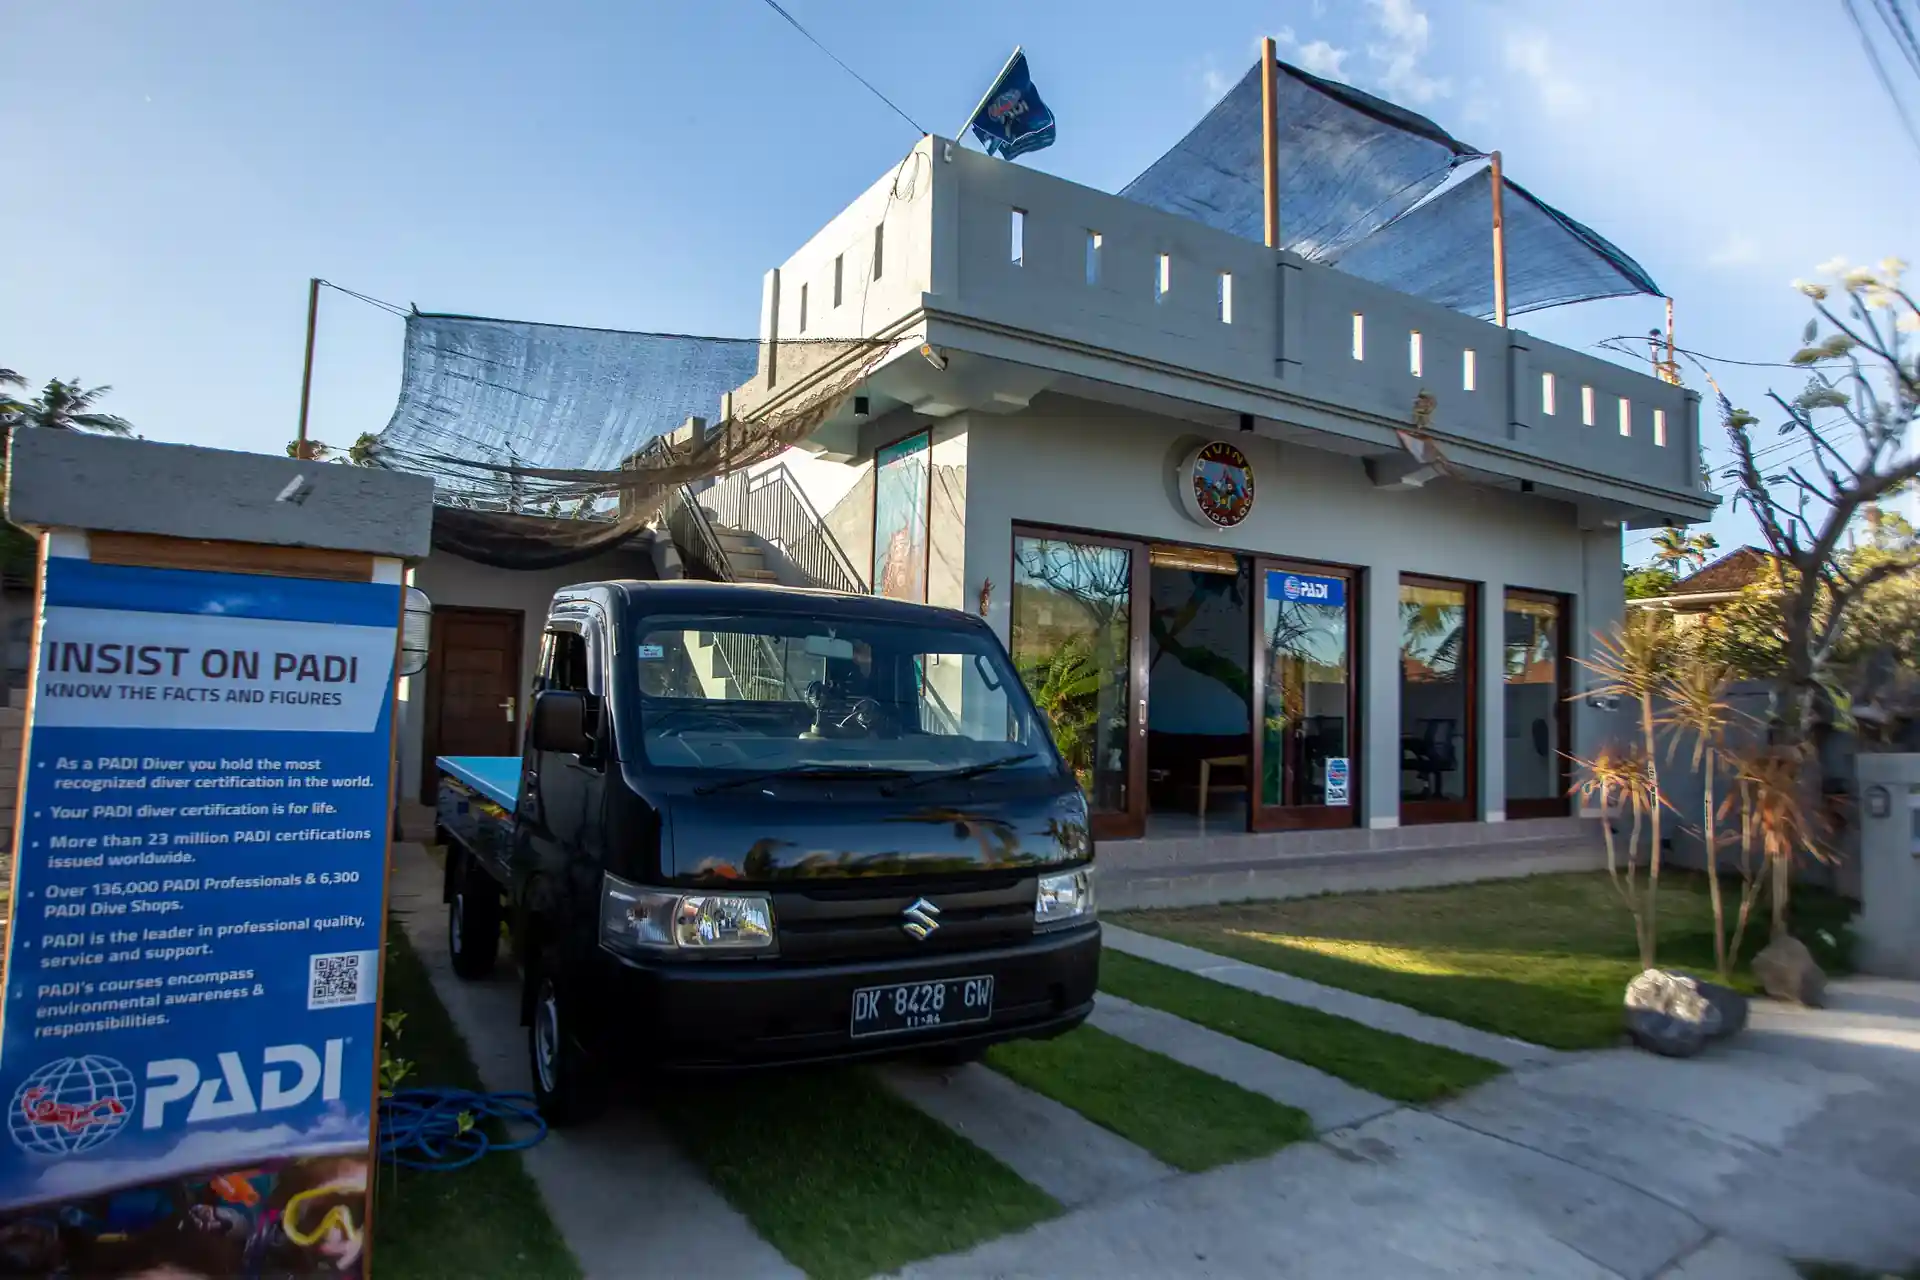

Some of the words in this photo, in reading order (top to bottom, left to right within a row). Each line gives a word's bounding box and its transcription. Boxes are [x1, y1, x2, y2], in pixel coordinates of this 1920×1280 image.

[1196, 445, 1252, 480] DIVING
[1202, 502, 1229, 524] VIDA
[1231, 487, 1253, 522] LOCA
[1300, 581, 1328, 599] PADI
[47, 641, 190, 677] INSIST
[201, 648, 259, 679] ON
[274, 652, 358, 683] PADI
[45, 683, 112, 699] KNOW
[117, 685, 158, 700] THE
[162, 686, 220, 702] FACTS
[225, 689, 265, 703] AND
[269, 690, 342, 706] FIGURES
[55, 756, 78, 770] As
[82, 760, 93, 770] a
[98, 757, 138, 770] PADI
[142, 757, 185, 770] Diver
[188, 760, 216, 773] you
[220, 758, 253, 770] hold
[257, 758, 281, 770] the
[285, 759, 322, 770] most
[54, 776, 146, 792] recognized
[151, 776, 191, 788] diver
[194, 776, 284, 788] certification
[288, 776, 301, 787] in
[306, 776, 328, 787] the
[331, 776, 374, 787] world.
[50, 806, 89, 819] Your
[93, 805, 132, 818] PADI
[136, 804, 175, 817] diver
[179, 803, 269, 816] certification
[272, 803, 284, 814] is
[288, 803, 309, 814] for
[312, 802, 338, 814] life.
[50, 835, 97, 848] More
[103, 834, 142, 847] than
[148, 833, 169, 845] 23
[174, 831, 229, 845] million
[234, 830, 271, 843] PADI
[275, 828, 372, 841] certifications
[48, 854, 104, 868] issued
[108, 851, 197, 866] worldwide.
[45, 885, 87, 899] Over
[93, 881, 159, 897] 136,000
[163, 878, 200, 893] PADI
[204, 874, 302, 890] Professionals
[305, 873, 316, 885] &
[320, 871, 360, 886] 6,300
[44, 903, 86, 918] PADI
[90, 902, 127, 915] Dive
[131, 899, 184, 914] Shops.
[42, 933, 84, 948] PADI
[90, 932, 104, 946] is
[110, 929, 138, 943] the
[143, 926, 195, 940] leader
[198, 924, 213, 936] in
[217, 918, 310, 938] professional
[314, 915, 365, 931] quality,
[40, 952, 104, 969] service
[108, 948, 140, 962] and
[145, 943, 214, 962] support.
[99, 976, 163, 992] courses
[167, 968, 254, 984] encompass
[36, 995, 160, 1019] environmental
[164, 987, 249, 1005] awareness
[252, 983, 265, 996] &
[855, 990, 881, 1021] DK
[894, 983, 946, 1015] 8428
[964, 979, 990, 1007] GW
[34, 1013, 171, 1039] responsibilities.
[142, 1037, 344, 1130] PADI
